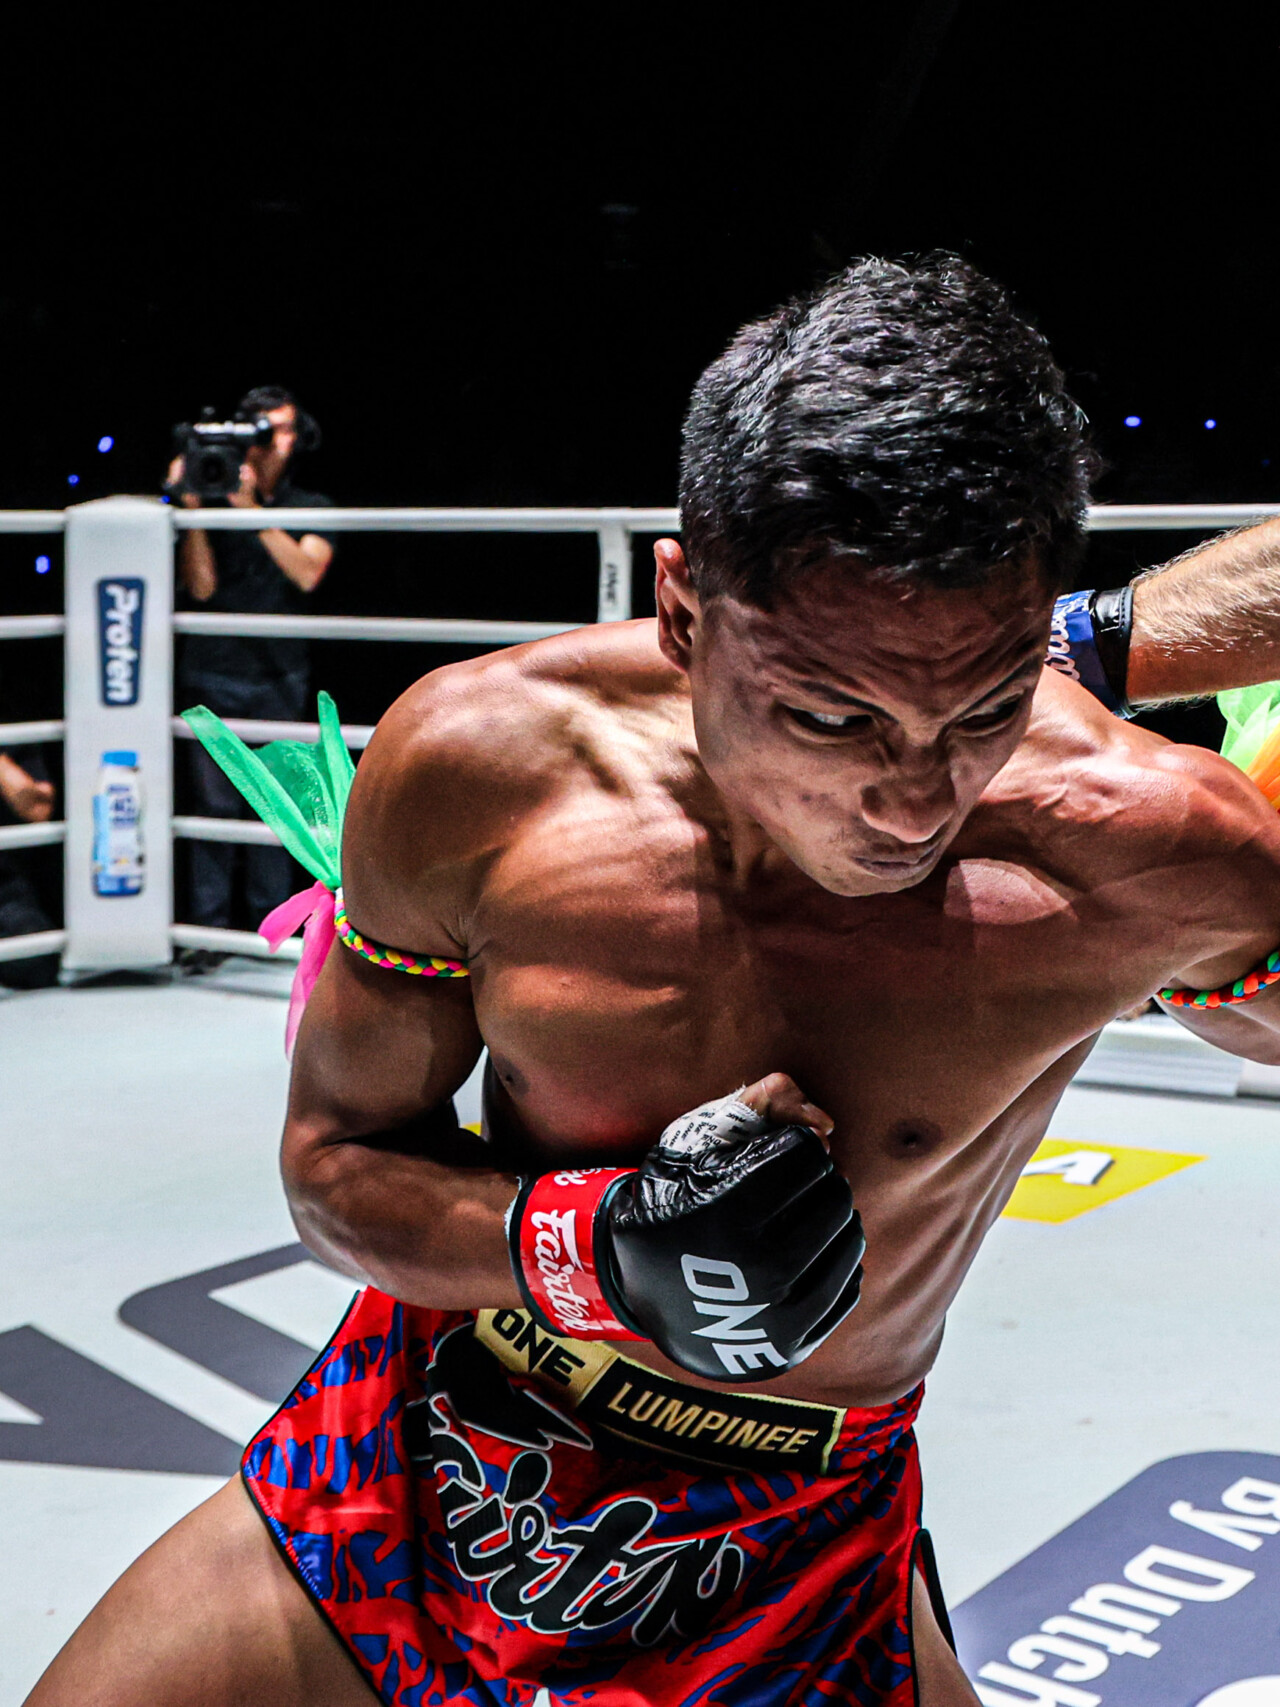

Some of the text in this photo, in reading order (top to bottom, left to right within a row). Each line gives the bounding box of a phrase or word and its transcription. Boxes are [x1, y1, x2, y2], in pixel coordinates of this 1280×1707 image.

[105, 583, 139, 702] Proten
[530, 1208, 604, 1332] Fairtex
[680, 1252, 788, 1376] ONE
[491, 1308, 820, 1455] ONE LUMPINEE
